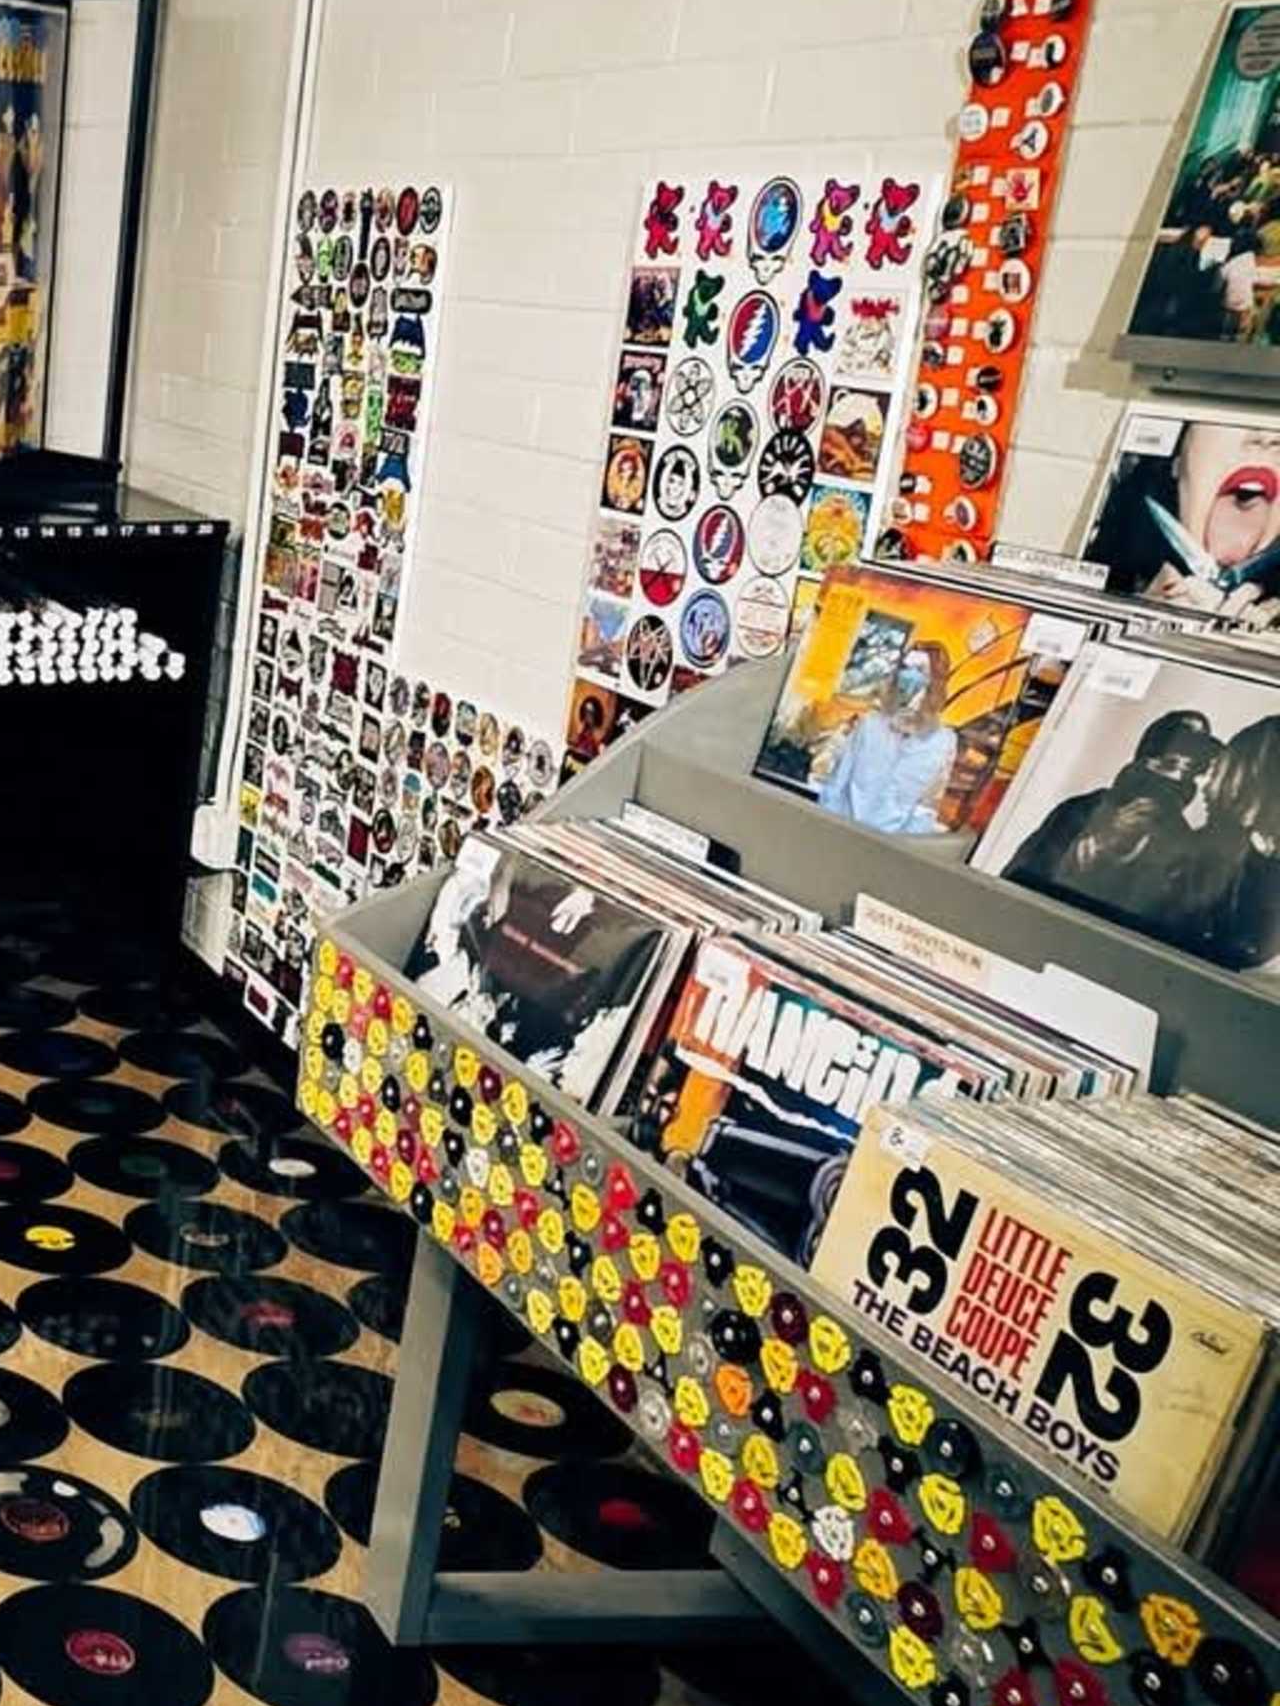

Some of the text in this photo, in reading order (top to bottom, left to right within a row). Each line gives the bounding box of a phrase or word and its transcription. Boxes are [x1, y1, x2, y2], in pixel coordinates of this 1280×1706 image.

[867, 1164, 979, 1317] 32
[960, 1250, 1057, 1336] DEUCE
[977, 1206, 1074, 1294] LITTLE
[850, 1278, 1121, 1484] THE BEACH BOYS
[944, 1293, 1038, 1384] COUPE
[1036, 1271, 1172, 1443] 32
